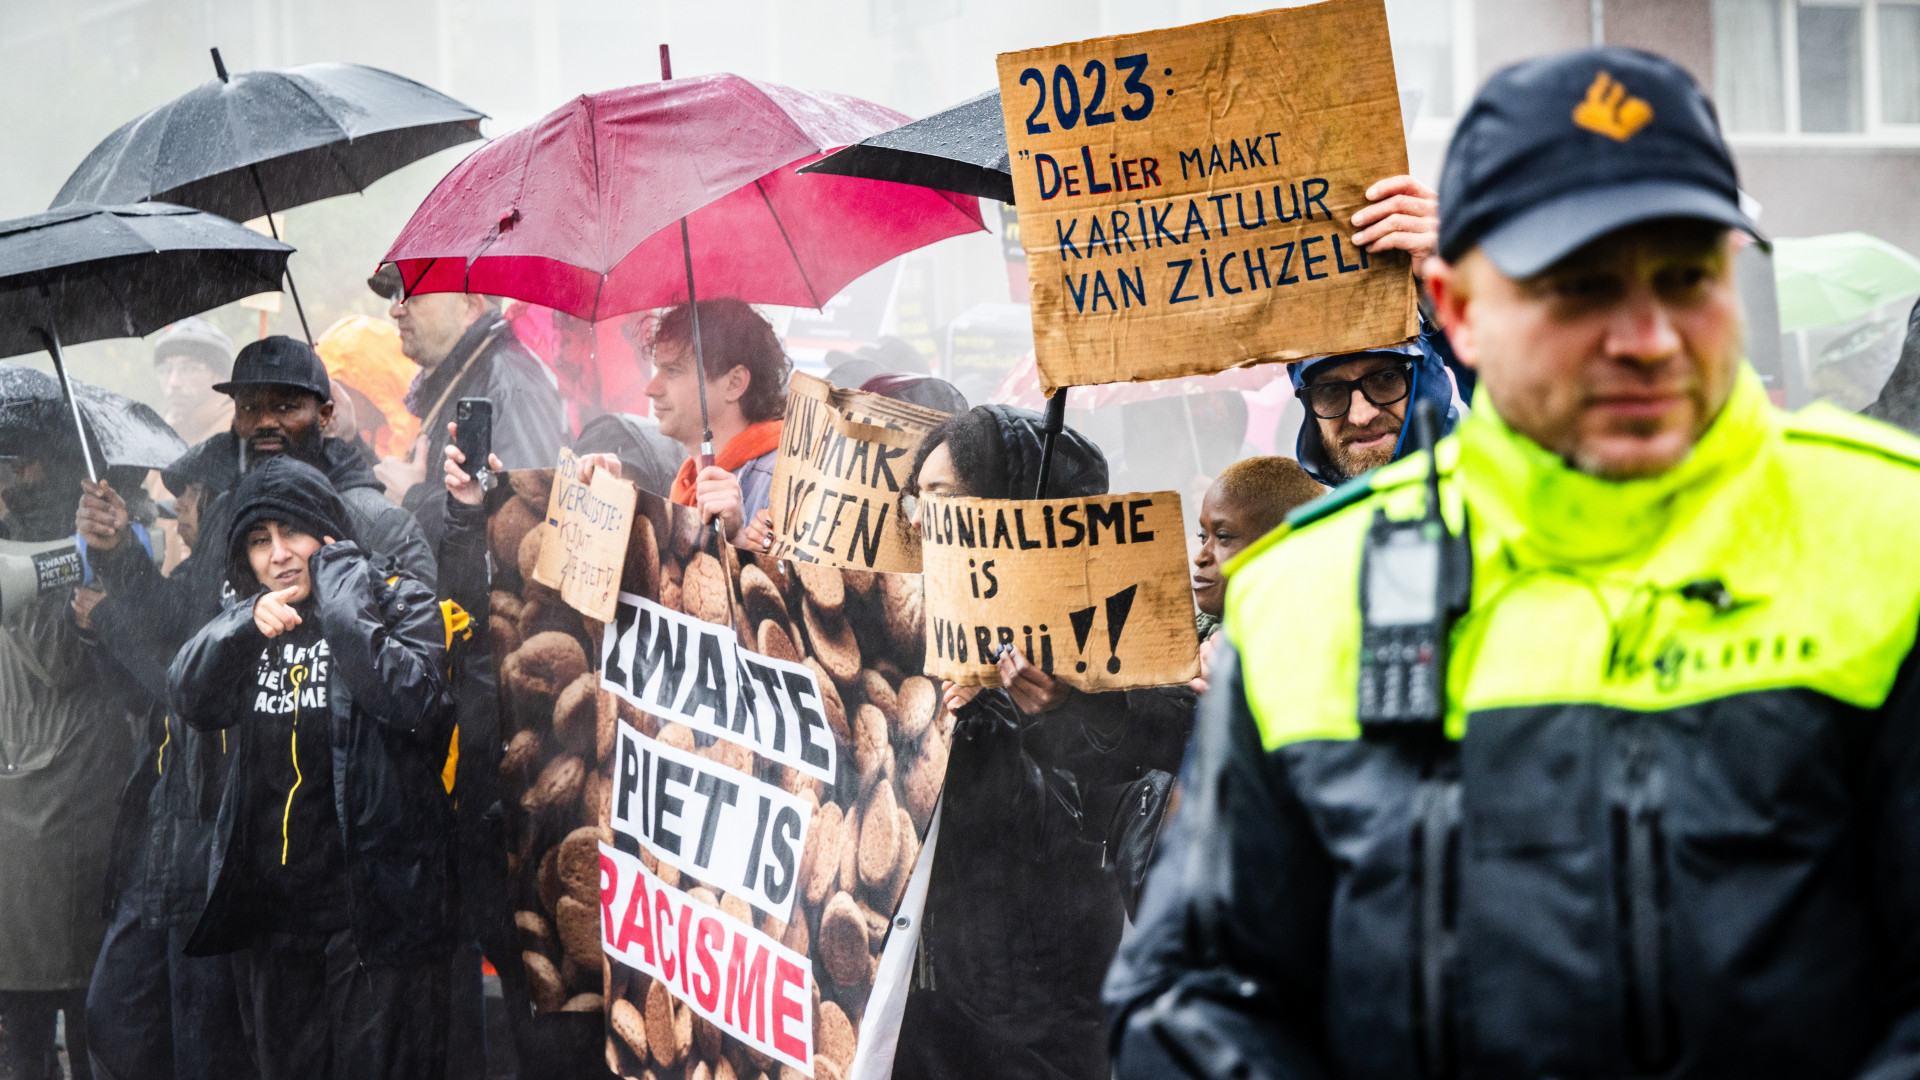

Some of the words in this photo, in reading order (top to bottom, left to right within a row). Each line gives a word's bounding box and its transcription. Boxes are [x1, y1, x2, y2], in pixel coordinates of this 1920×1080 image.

[1179, 132, 1281, 181] MAAKT
[1065, 266, 1147, 313] VAN
[814, 406, 908, 492] HAAR
[38, 552, 79, 571] ZWARTE
[40, 567, 61, 581] PIET
[261, 638, 330, 664] ARTE
[1646, 636, 1818, 680] LITIE
[617, 732, 740, 870] PIET
[743, 795, 801, 904] IS
[600, 853, 808, 1065] RACISME
